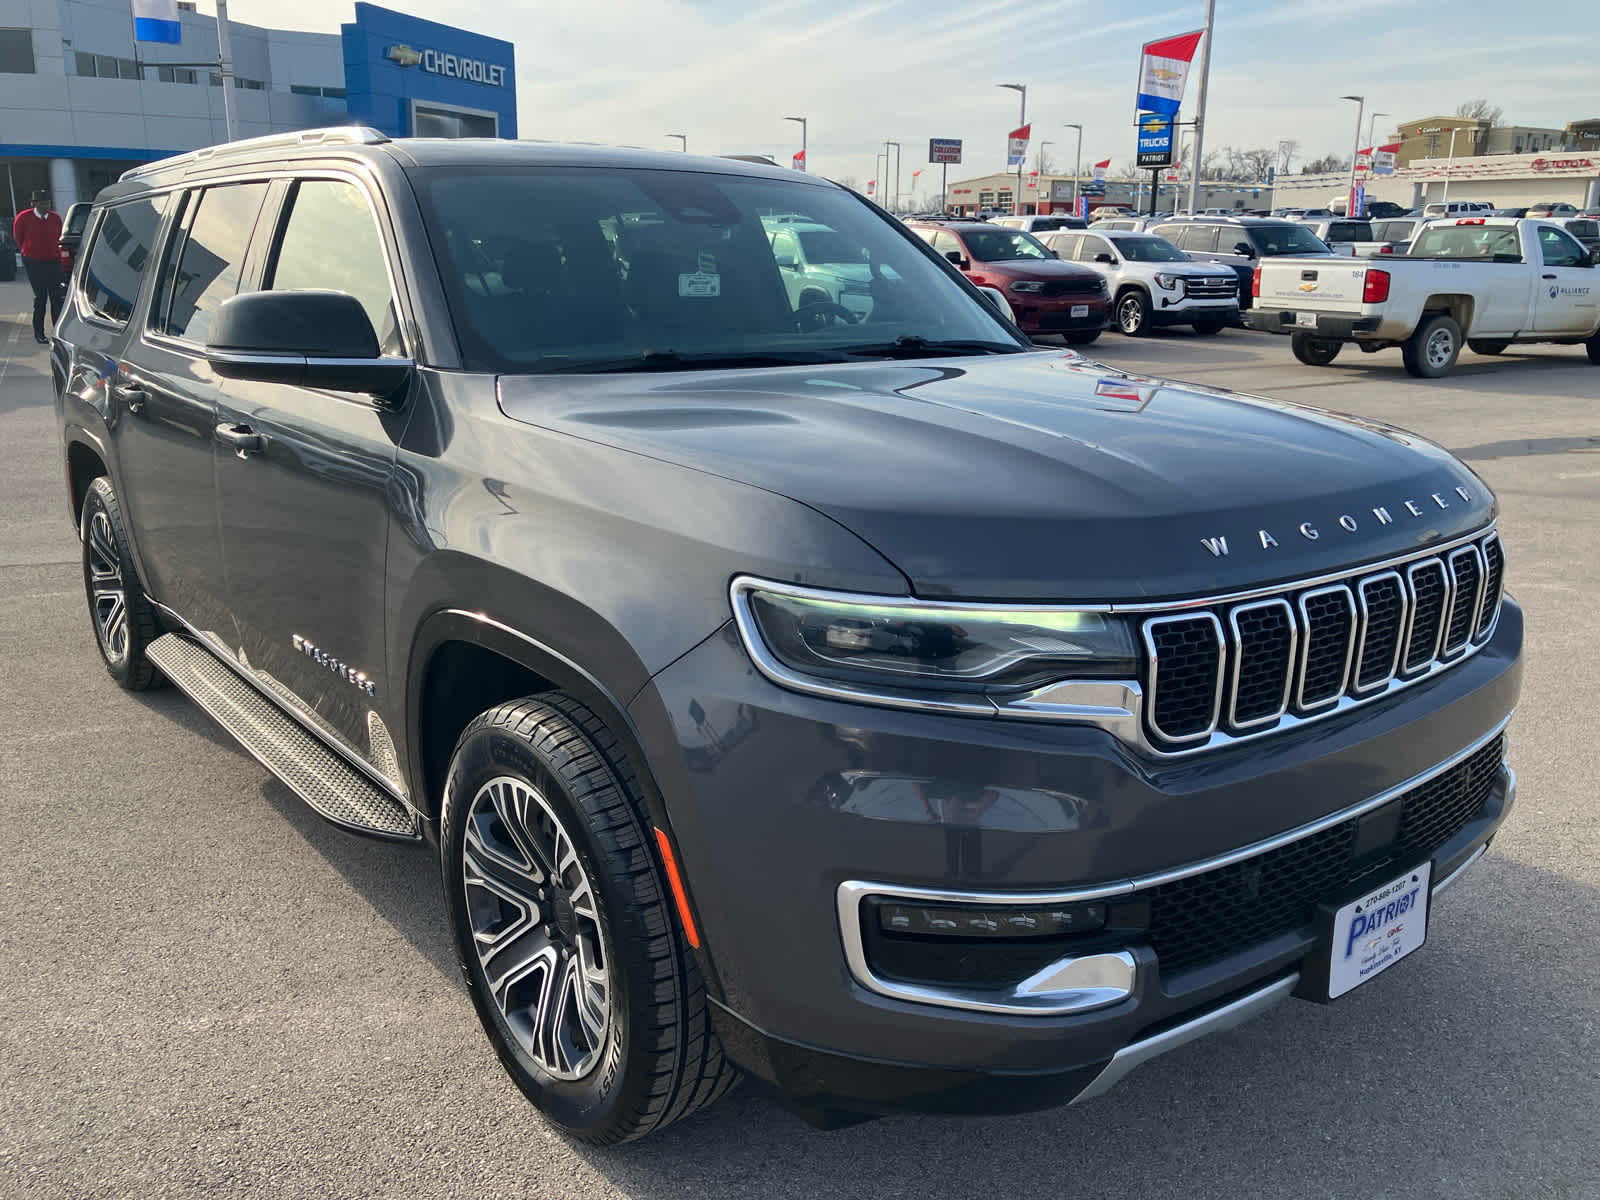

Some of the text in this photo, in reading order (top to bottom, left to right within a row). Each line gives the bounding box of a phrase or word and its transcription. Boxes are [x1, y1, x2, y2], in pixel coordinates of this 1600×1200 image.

[424, 49, 506, 87] CHEVROLET
[1139, 137, 1169, 148] TRUCKS
[1140, 154, 1165, 162] PATRIOT
[1550, 159, 1592, 169] TOYOTA
[1560, 287, 1590, 295] ALLIANCE
[1200, 486, 1472, 557] WAGONEER
[1343, 887, 1420, 960] PATRIOT
